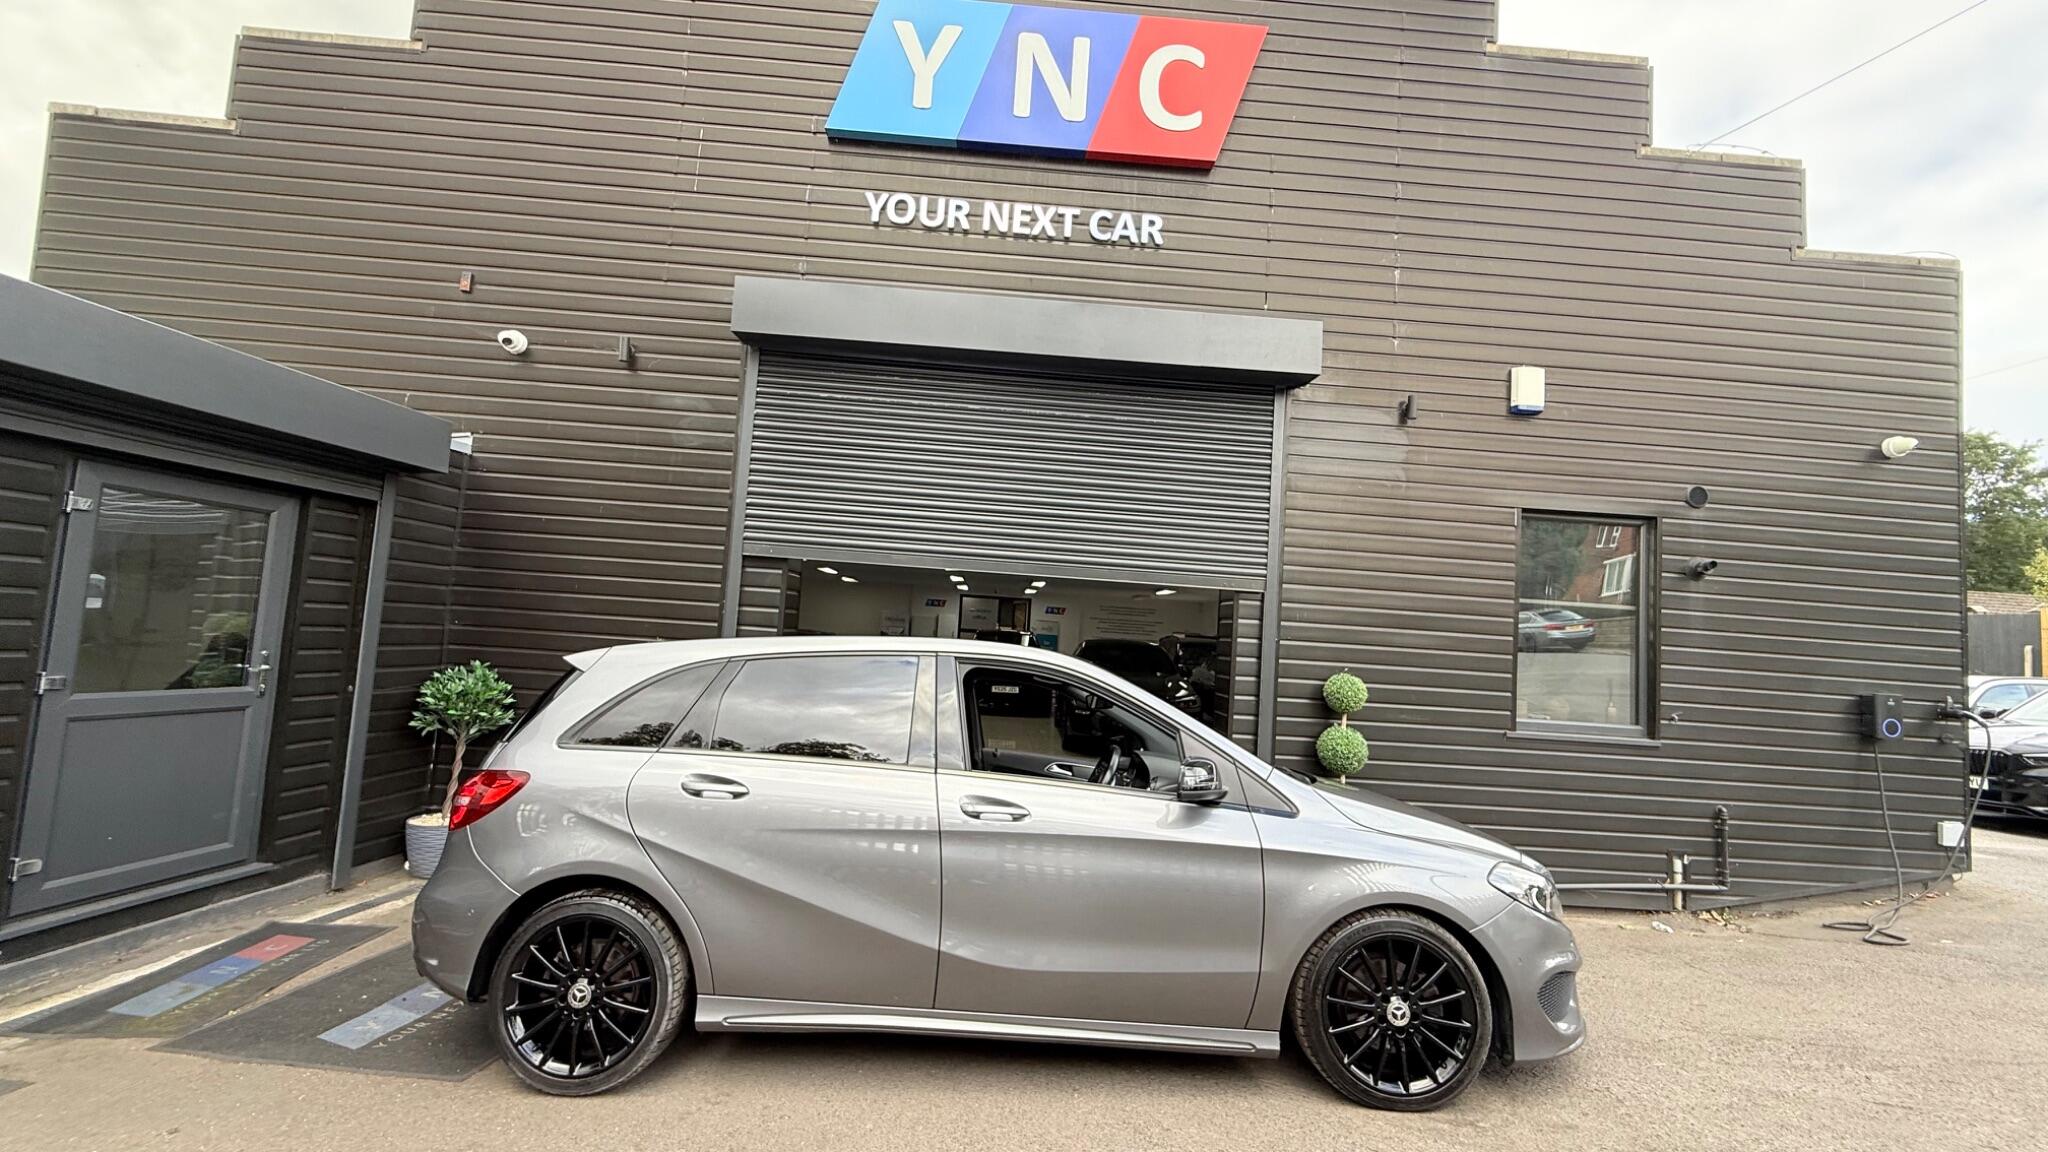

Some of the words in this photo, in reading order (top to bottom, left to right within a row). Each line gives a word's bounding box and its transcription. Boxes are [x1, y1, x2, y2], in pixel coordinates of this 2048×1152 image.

[893, 20, 1204, 131] YNC
[864, 191, 970, 230] YOUR
[982, 200, 1080, 238] NEXT
[1089, 210, 1163, 245] CAR
[371, 1022, 432, 1048] YOUR
